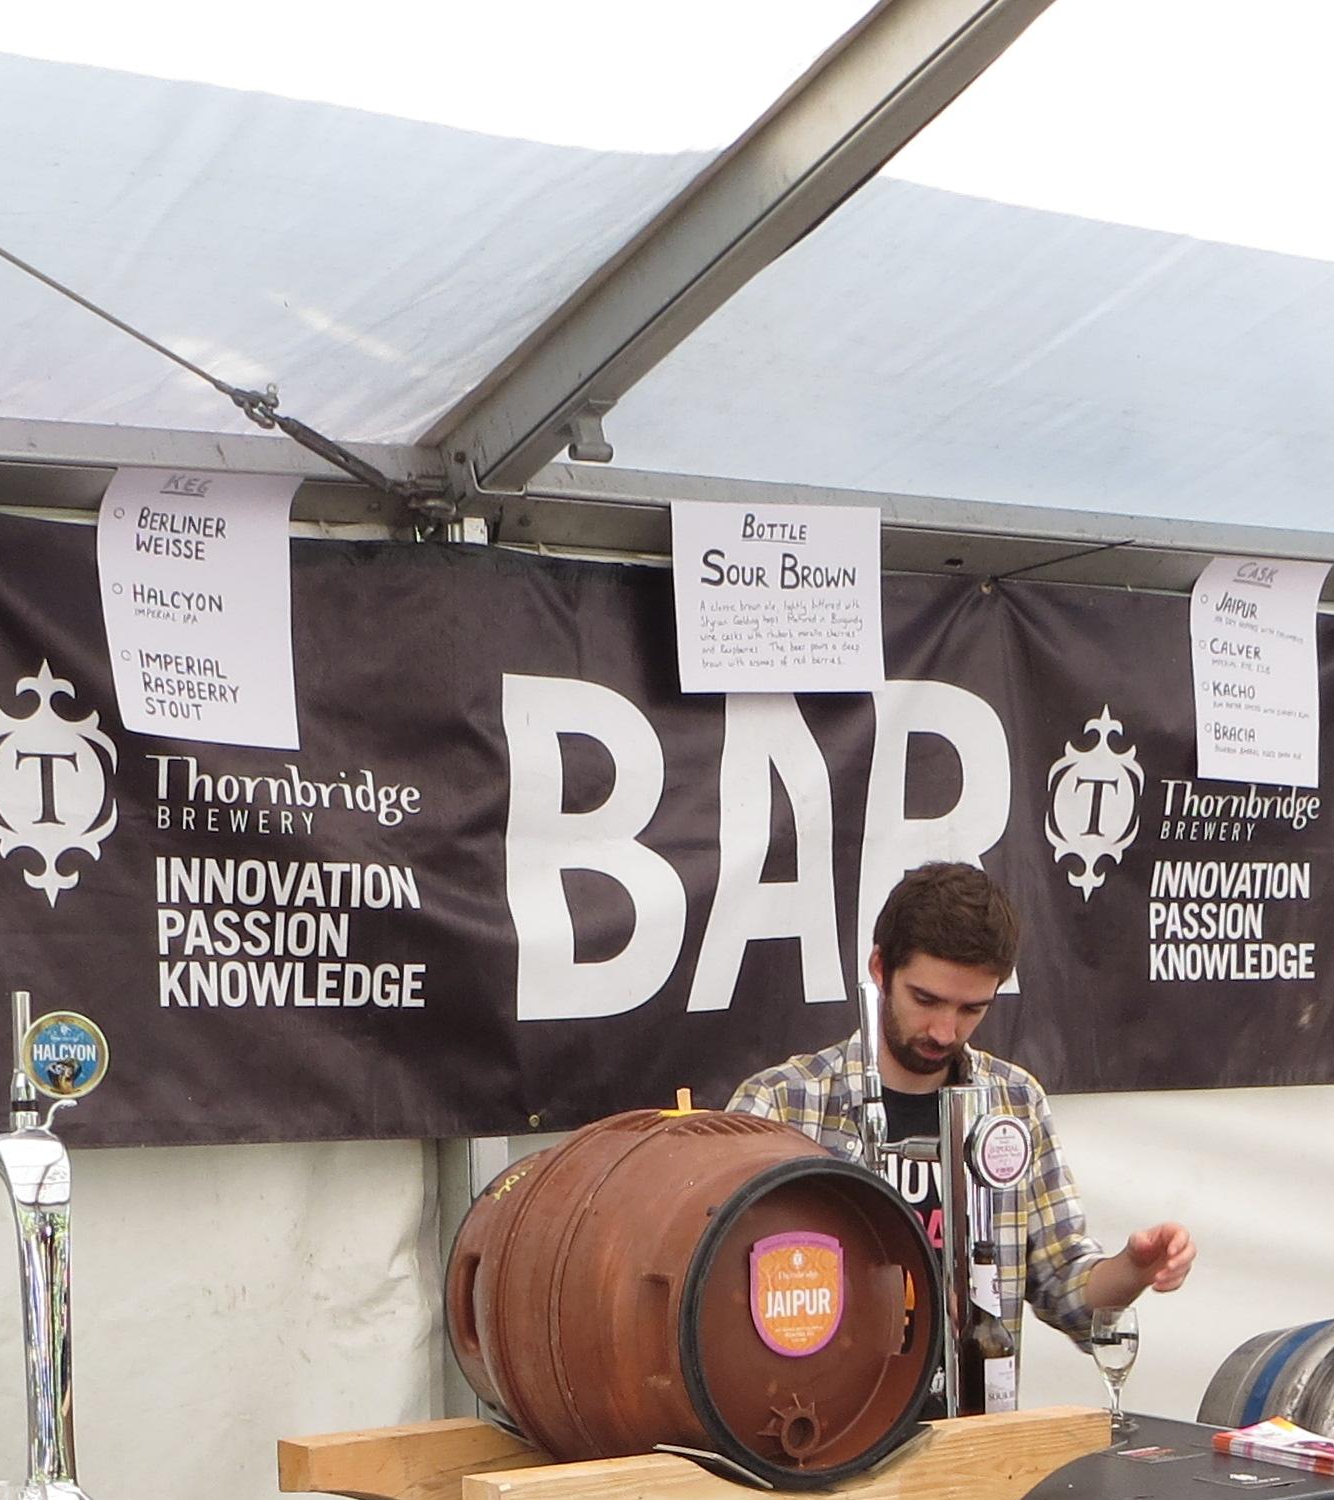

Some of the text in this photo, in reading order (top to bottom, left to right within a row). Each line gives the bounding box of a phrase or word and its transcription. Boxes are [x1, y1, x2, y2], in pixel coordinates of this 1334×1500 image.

[162, 474, 212, 495] KEG
[137, 506, 227, 539] BERLINER
[135, 533, 206, 561] WEISSE
[132, 583, 224, 613] HALCYON
[1215, 591, 1258, 620] JAIPUR
[138, 649, 228, 680] IMPERIAL
[1209, 637, 1262, 661] CALVER
[141, 671, 240, 704] RASPBERRY
[1212, 681, 1256, 701] KACHO
[145, 696, 203, 721] STOUT
[1213, 721, 1256, 743] BRACIA
[15, 752, 80, 826] T
[145, 754, 422, 827] Thornbridge
[1159, 778, 1322, 831] Thornbridge
[156, 805, 316, 837] BREWERY
[1159, 820, 1258, 843] BREWERY
[503, 672, 1021, 1022] BAR
[155, 855, 422, 912] INNOVATION
[1149, 860, 1312, 901] INNOVATION
[158, 910, 350, 958] PASSION
[1149, 902, 1264, 941] PASSION
[1149, 941, 1316, 982] KNOWLEDGE
[158, 960, 426, 1009] KNOWLEDGE
[32, 1043, 96, 1062] HALCYON
[765, 1287, 832, 1319] JAIPUR
